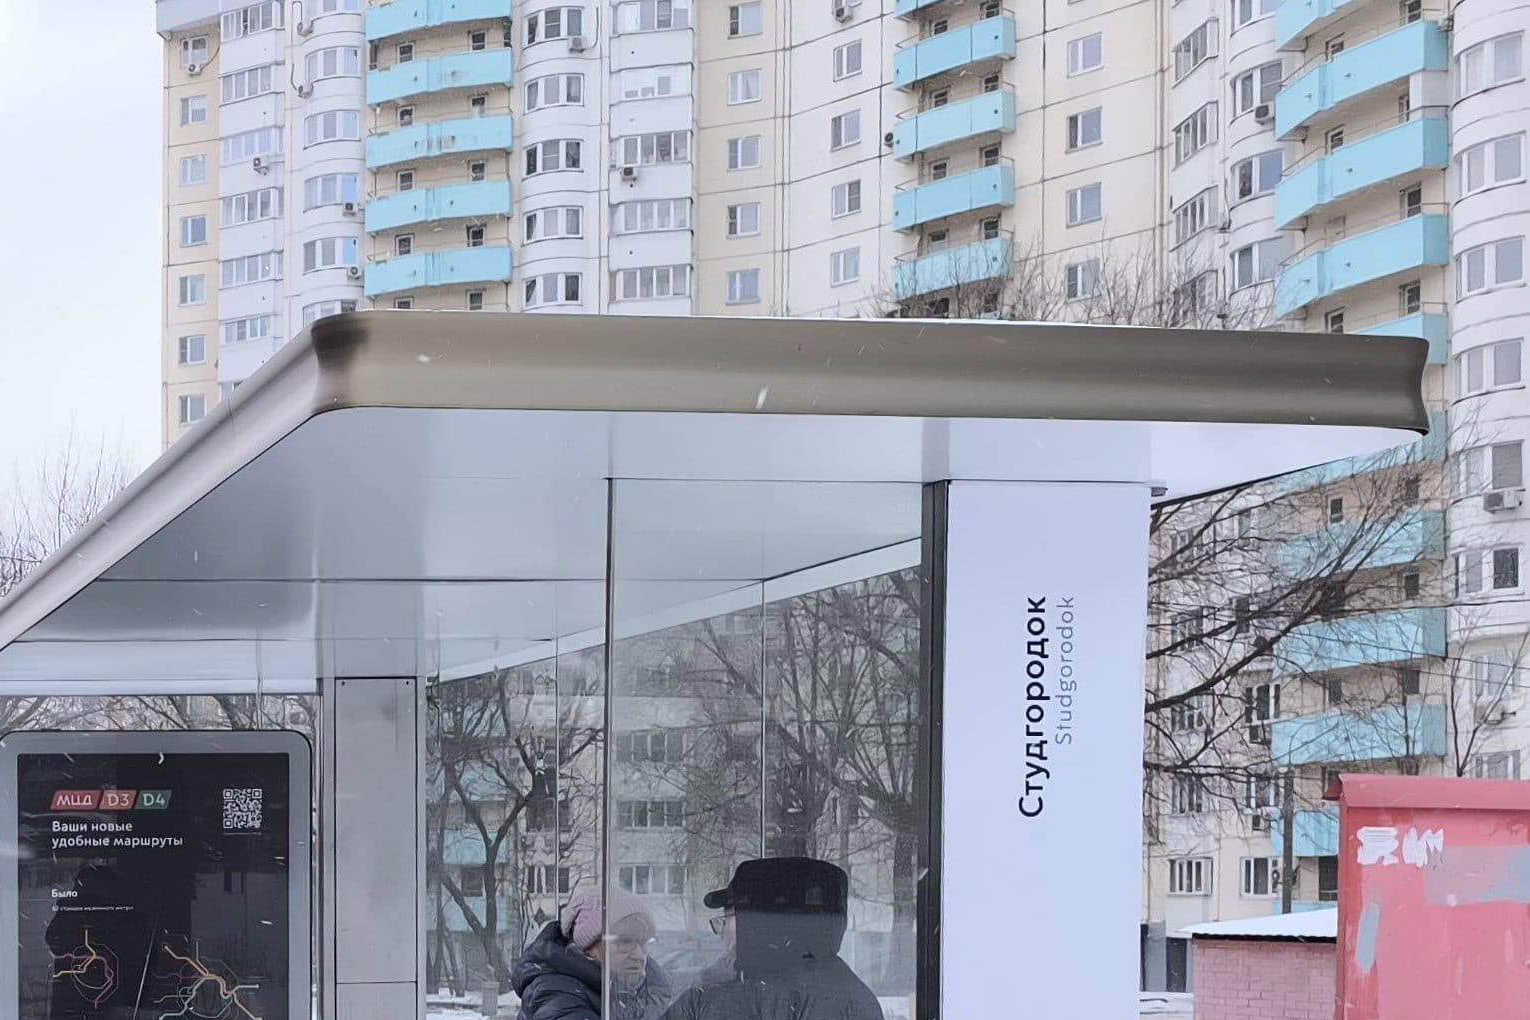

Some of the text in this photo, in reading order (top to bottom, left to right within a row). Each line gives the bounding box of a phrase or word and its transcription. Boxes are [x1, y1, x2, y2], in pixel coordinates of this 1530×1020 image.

[1055, 597, 1077, 744] Studgorodok
[1019, 596, 1050, 817] Студгородок
[56, 793, 166, 807] МЦД D3 D4
[52, 820, 133, 832] Ваши новые
[51, 834, 183, 849] удобные маршруты
[51, 888, 78, 898] Было
